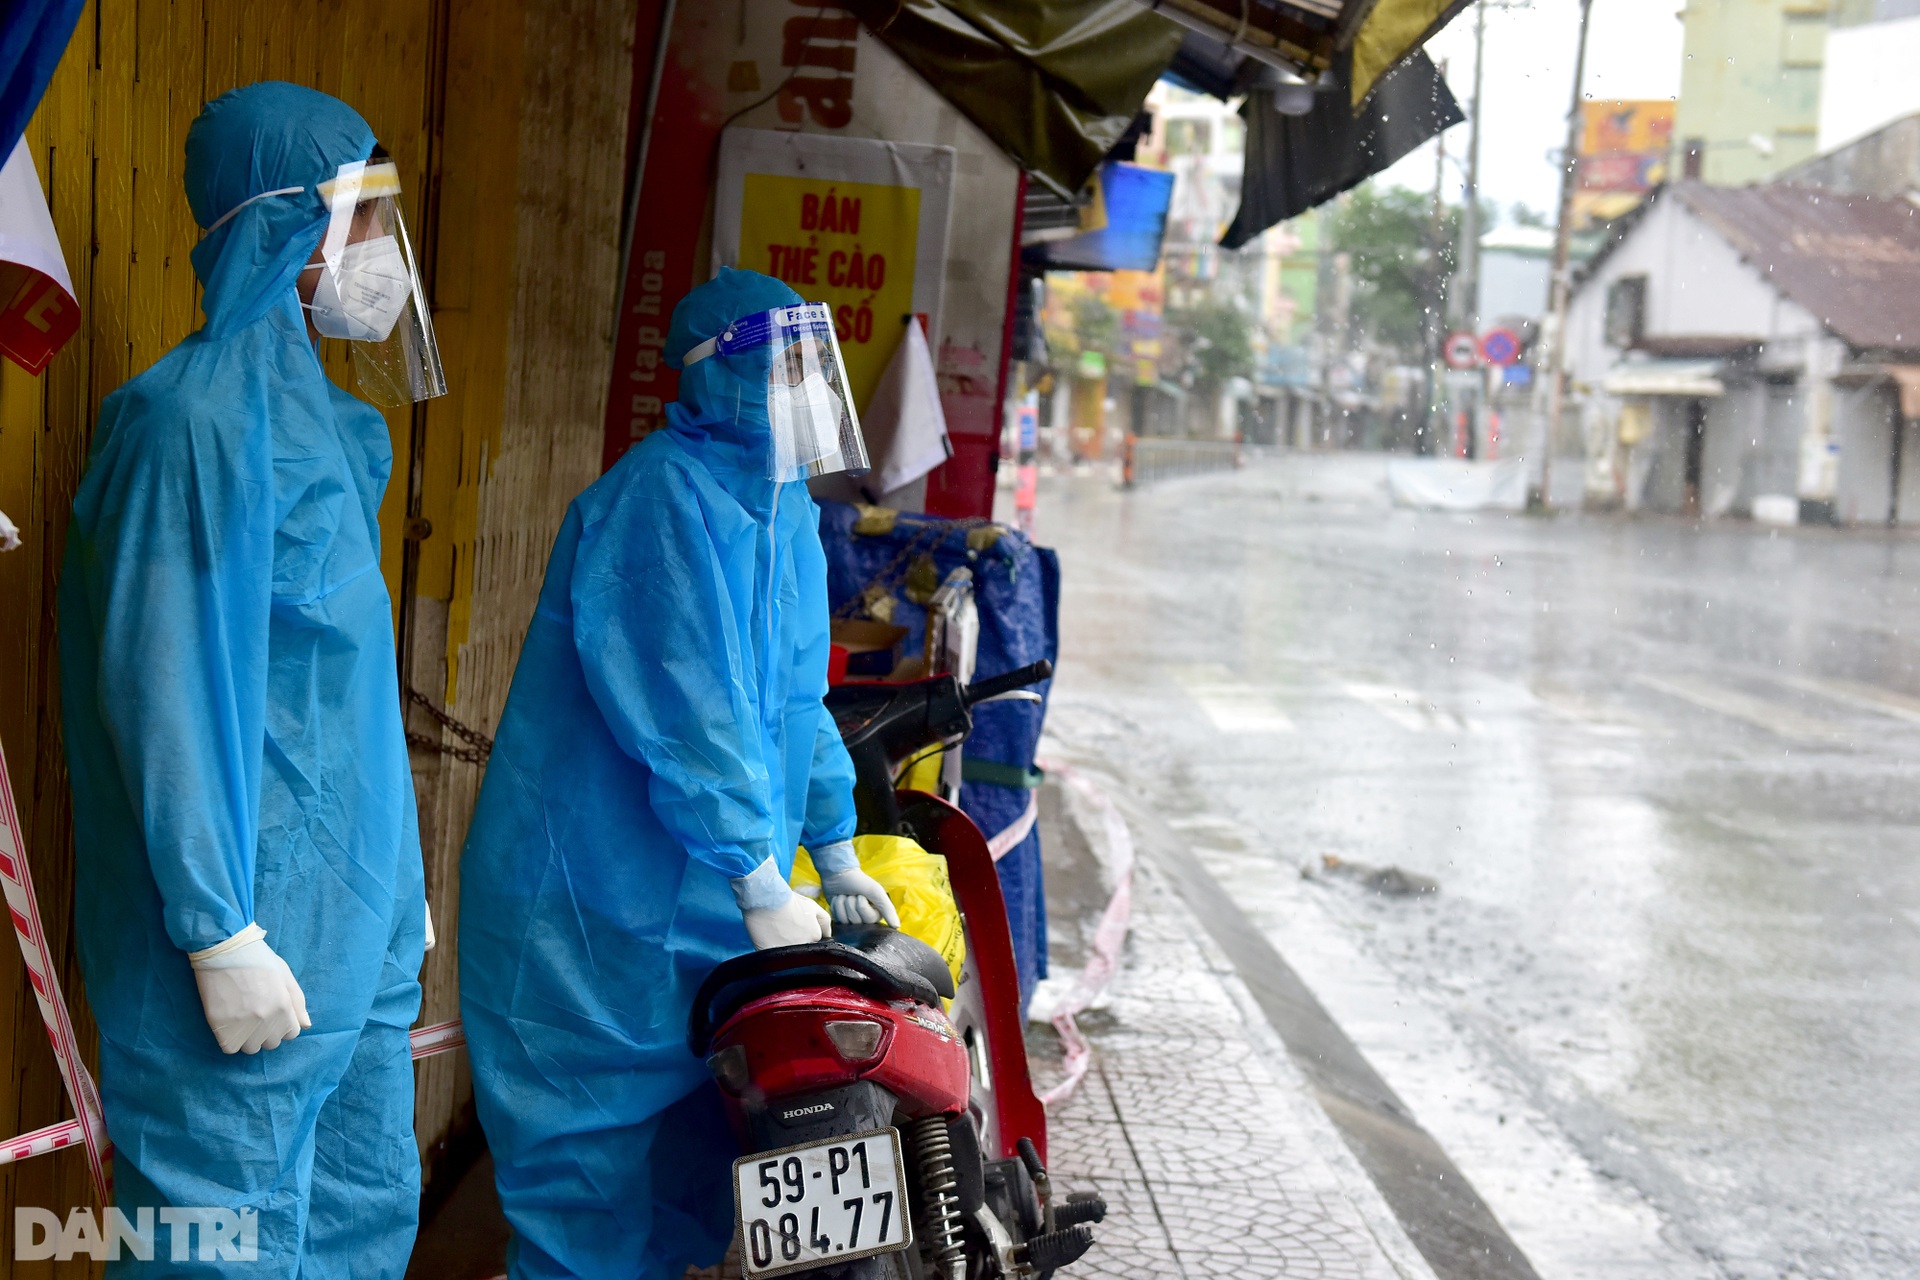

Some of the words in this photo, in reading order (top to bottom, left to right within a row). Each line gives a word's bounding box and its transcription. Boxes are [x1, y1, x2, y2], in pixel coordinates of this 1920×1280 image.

[801, 187, 862, 235] BÁN
[827, 243, 886, 291] CÀO
[786, 310, 817, 322] Face
[783, 1102, 835, 1119] HONDA
[757, 1141, 871, 1208] 59-P1
[750, 1190, 894, 1268] 084.77
